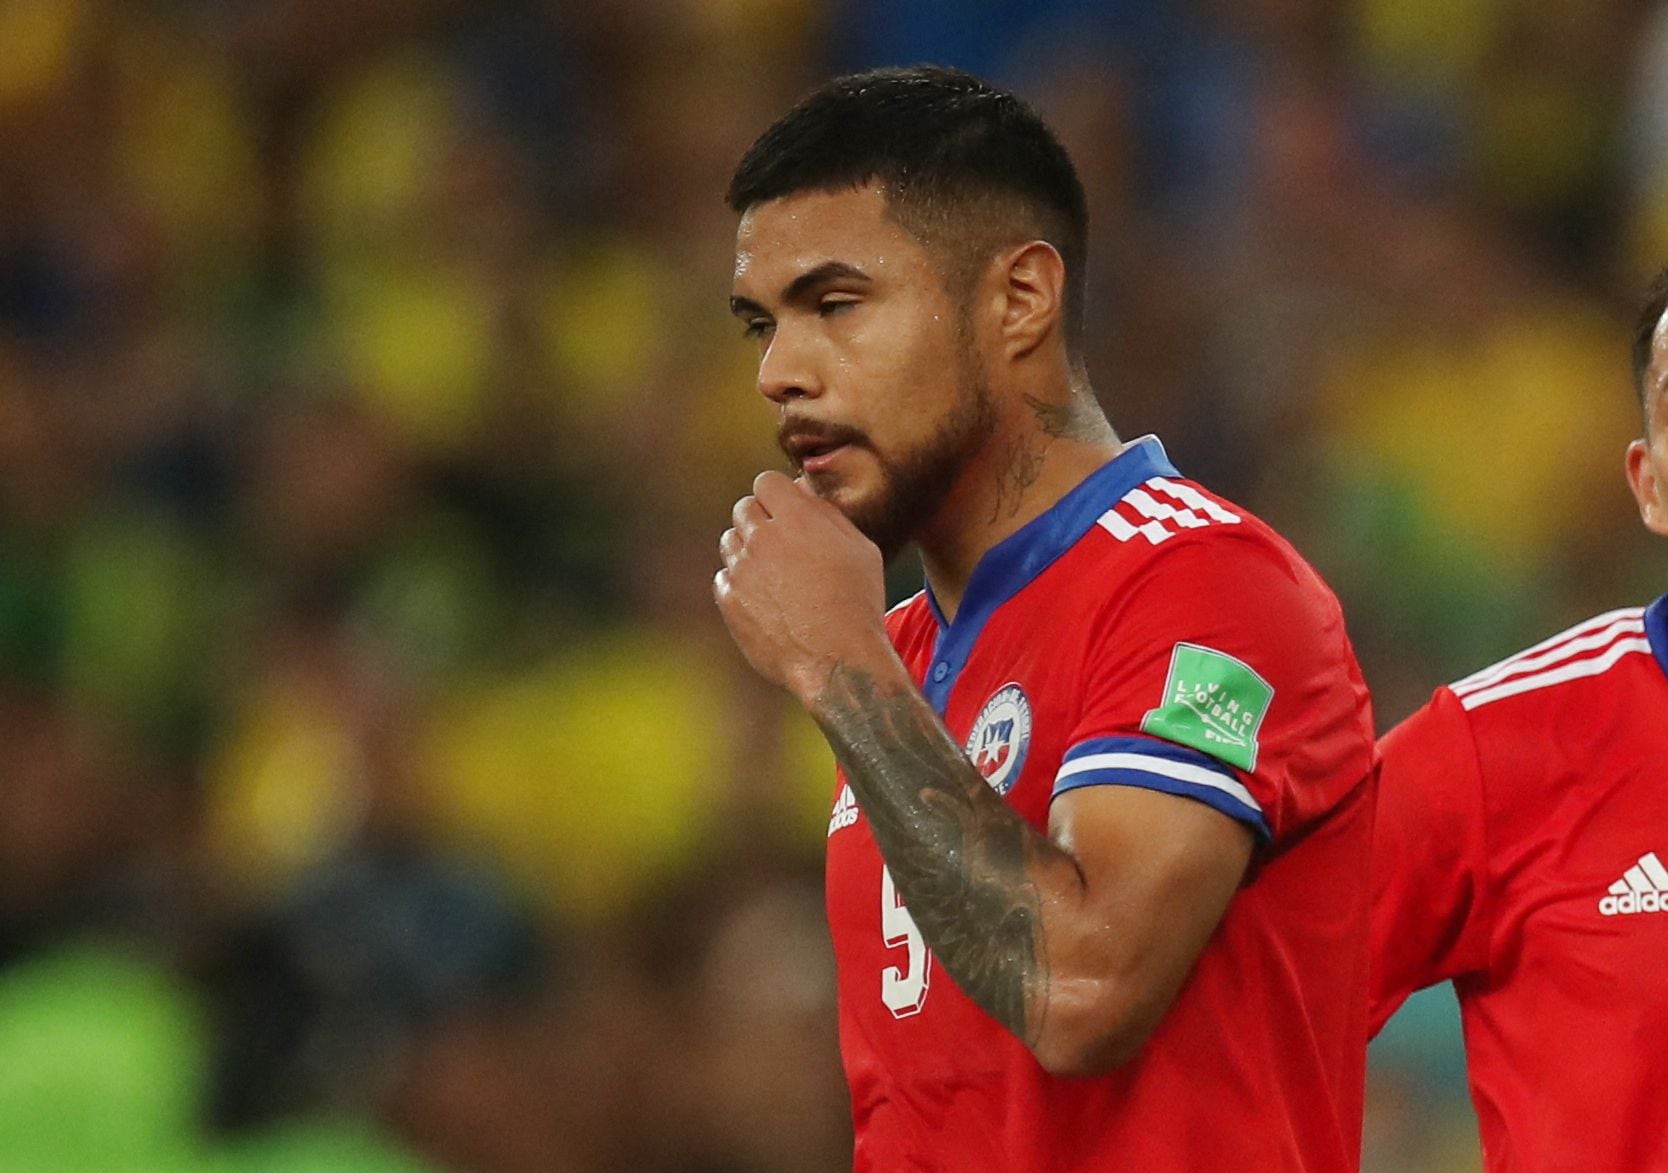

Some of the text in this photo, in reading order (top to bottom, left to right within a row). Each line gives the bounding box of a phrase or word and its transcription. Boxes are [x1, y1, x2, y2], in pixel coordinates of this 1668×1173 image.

[1174, 691, 1247, 738] FOTBALL
[1177, 680, 1253, 725] LIVING
[1204, 729, 1246, 747] FI
[881, 863, 933, 1019] 5
